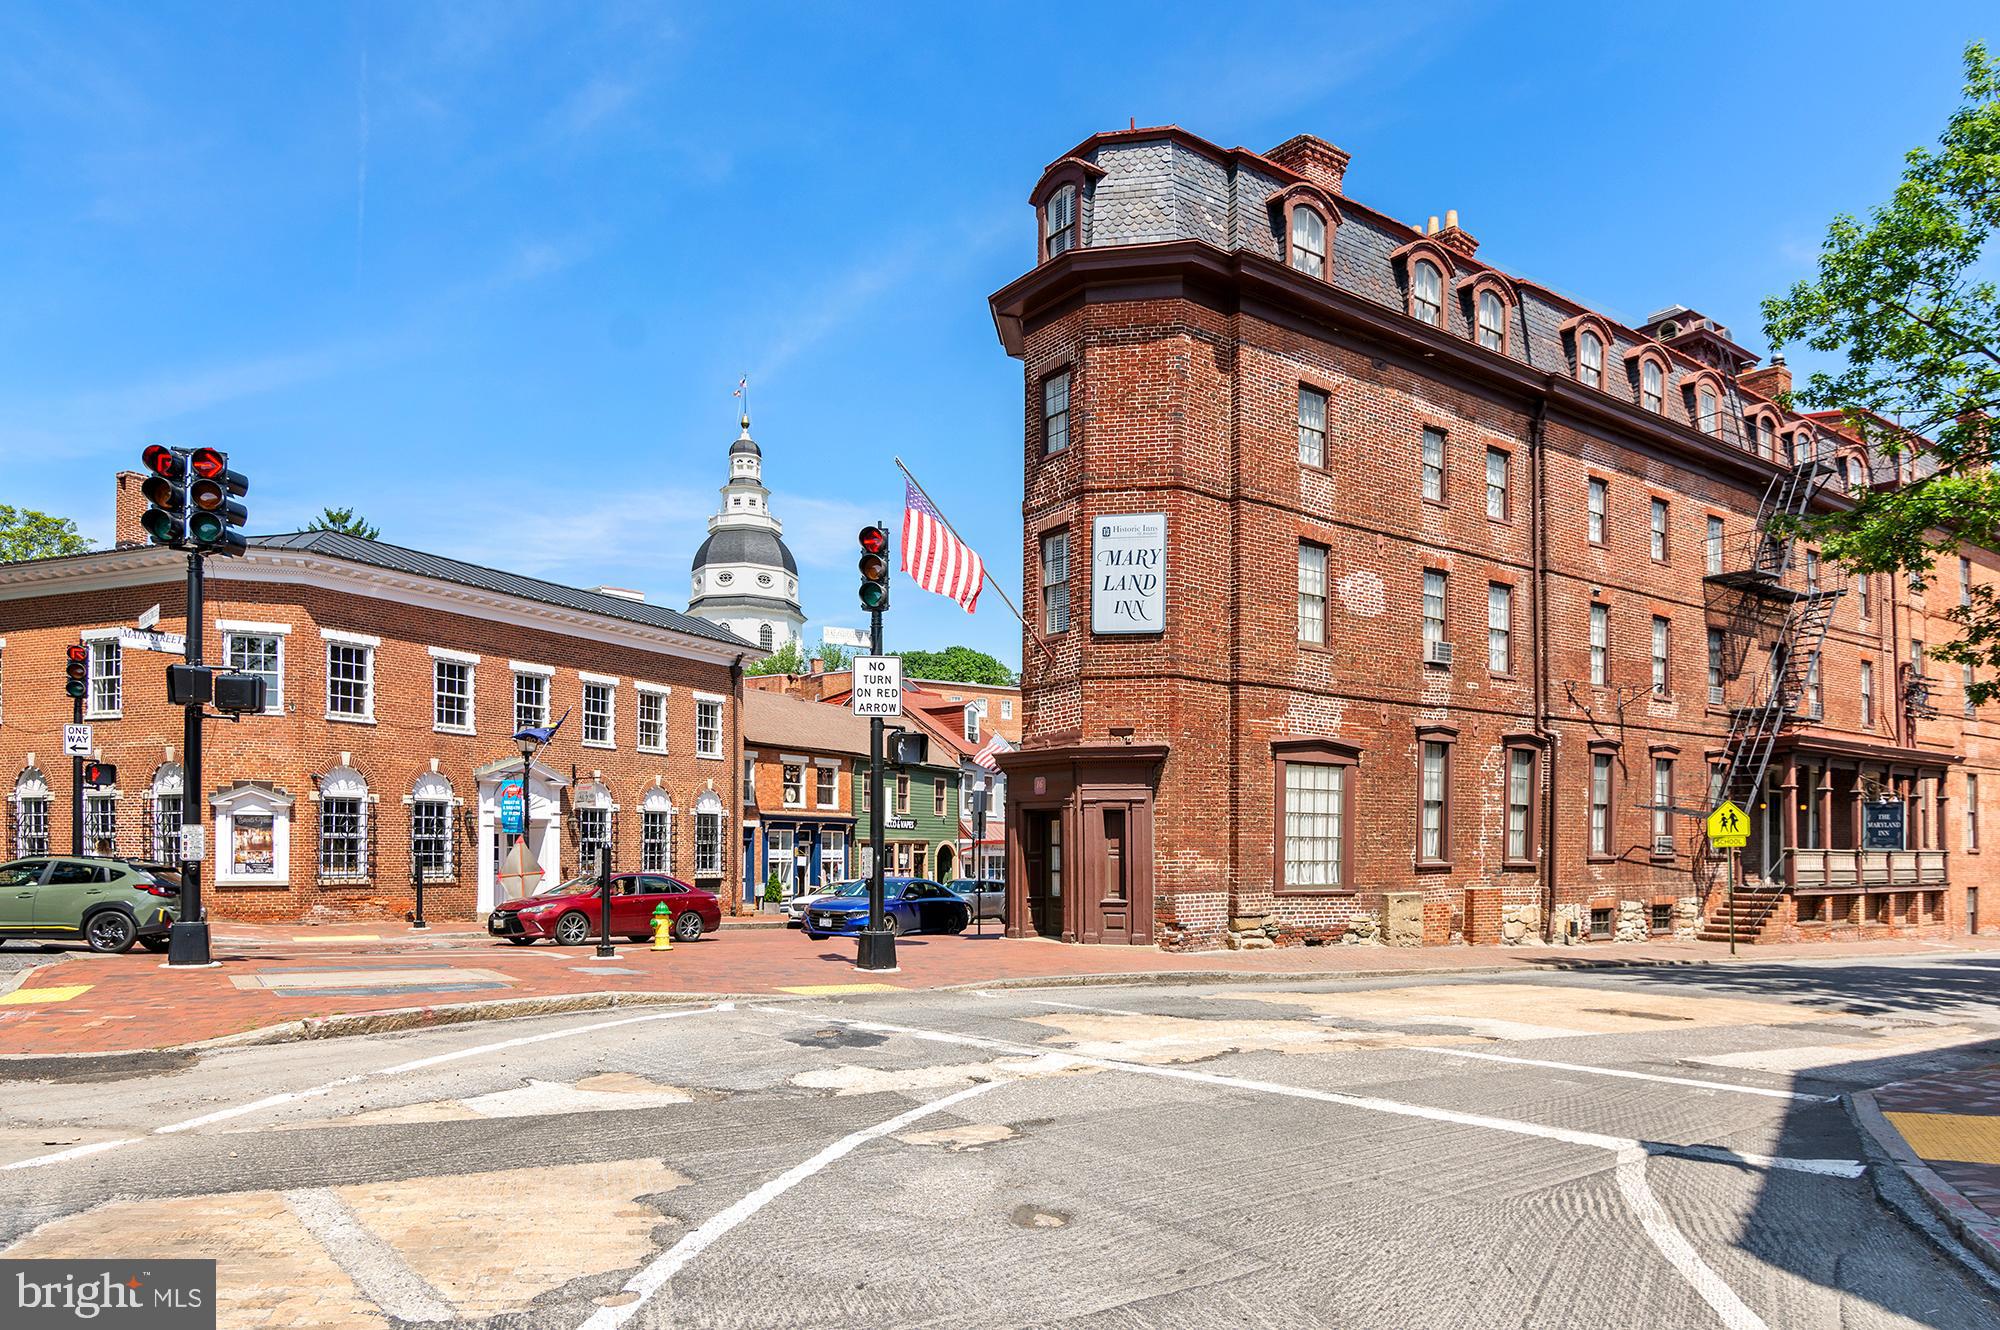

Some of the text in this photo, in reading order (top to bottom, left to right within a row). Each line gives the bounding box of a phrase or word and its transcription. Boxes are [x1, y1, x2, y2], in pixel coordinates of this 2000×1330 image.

[1112, 525, 1140, 533] Historic
[1097, 548, 1162, 569] MARY
[1102, 573, 1157, 597] LAND
[1114, 600, 1152, 621] INN
[122, 629, 183, 644] MAIN STREET
[869, 662, 885, 671] NO
[863, 675, 892, 684] TURN
[856, 688, 898, 698] ON RED
[858, 703, 896, 712] ARROW
[68, 726, 88, 735] ONE
[67, 735, 88, 743] WAY
